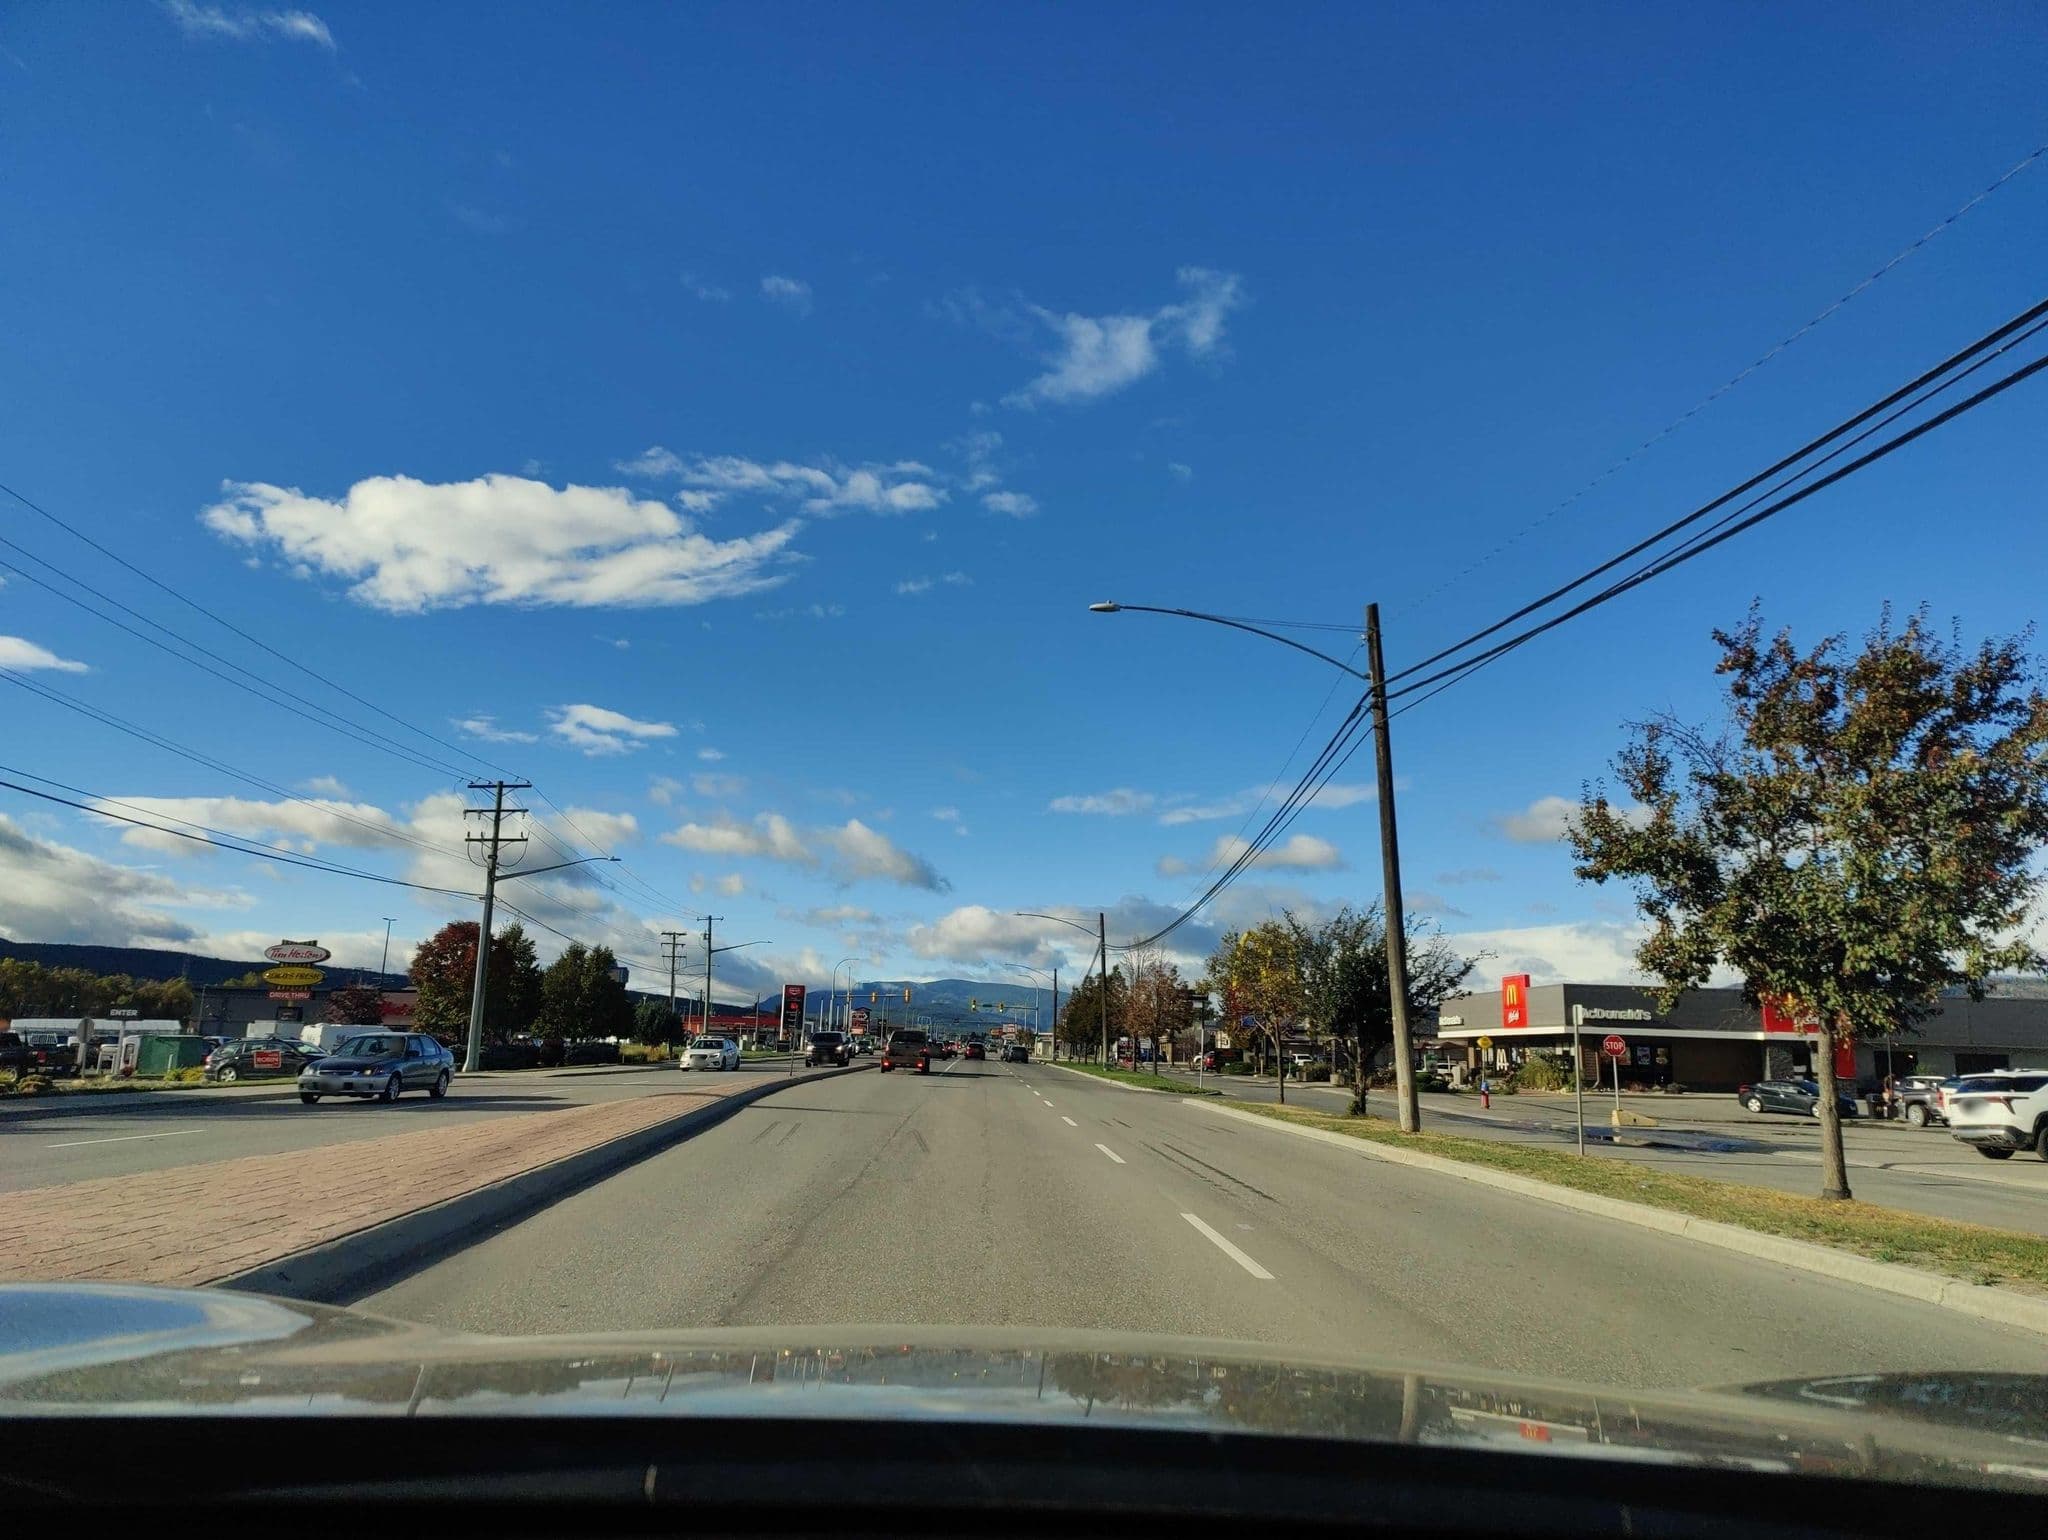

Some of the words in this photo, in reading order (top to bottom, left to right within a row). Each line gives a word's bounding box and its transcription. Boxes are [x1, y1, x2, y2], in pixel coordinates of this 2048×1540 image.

[271, 948, 287, 958] Tim
[288, 948, 323, 959] Hortons
[110, 1009, 138, 1017] ENTER
[1605, 1041, 1623, 1050] STOP
